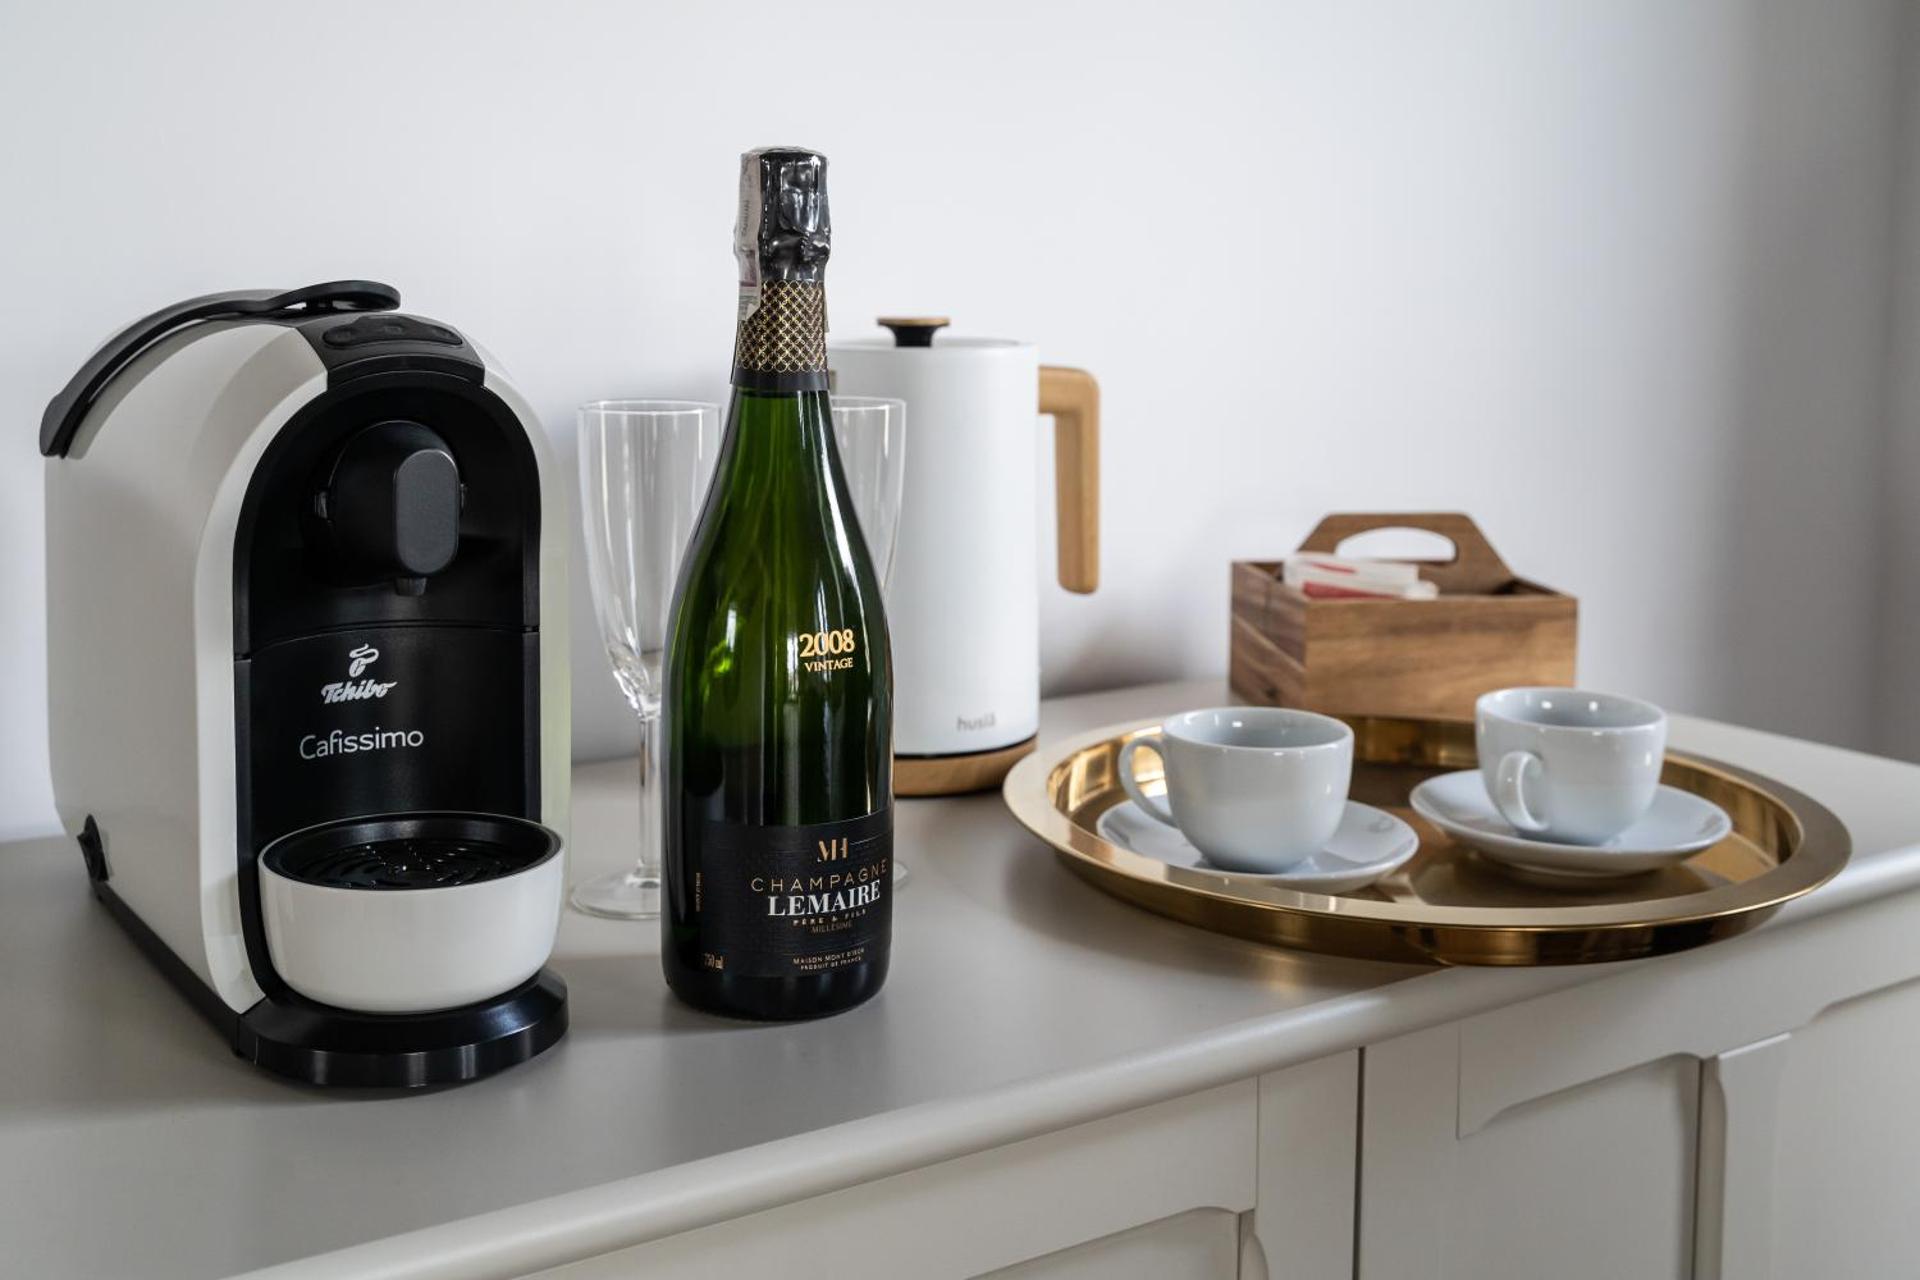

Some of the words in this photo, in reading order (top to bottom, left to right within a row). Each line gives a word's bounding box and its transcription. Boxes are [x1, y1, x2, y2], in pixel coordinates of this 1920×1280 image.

[799, 629, 855, 658] 2008
[804, 657, 854, 672] VINTAGE
[321, 679, 398, 704] Tchibo
[299, 726, 424, 760] Cafissimo
[750, 857, 888, 892] CHAMPAGNE
[768, 879, 880, 916] LEMAIRE
